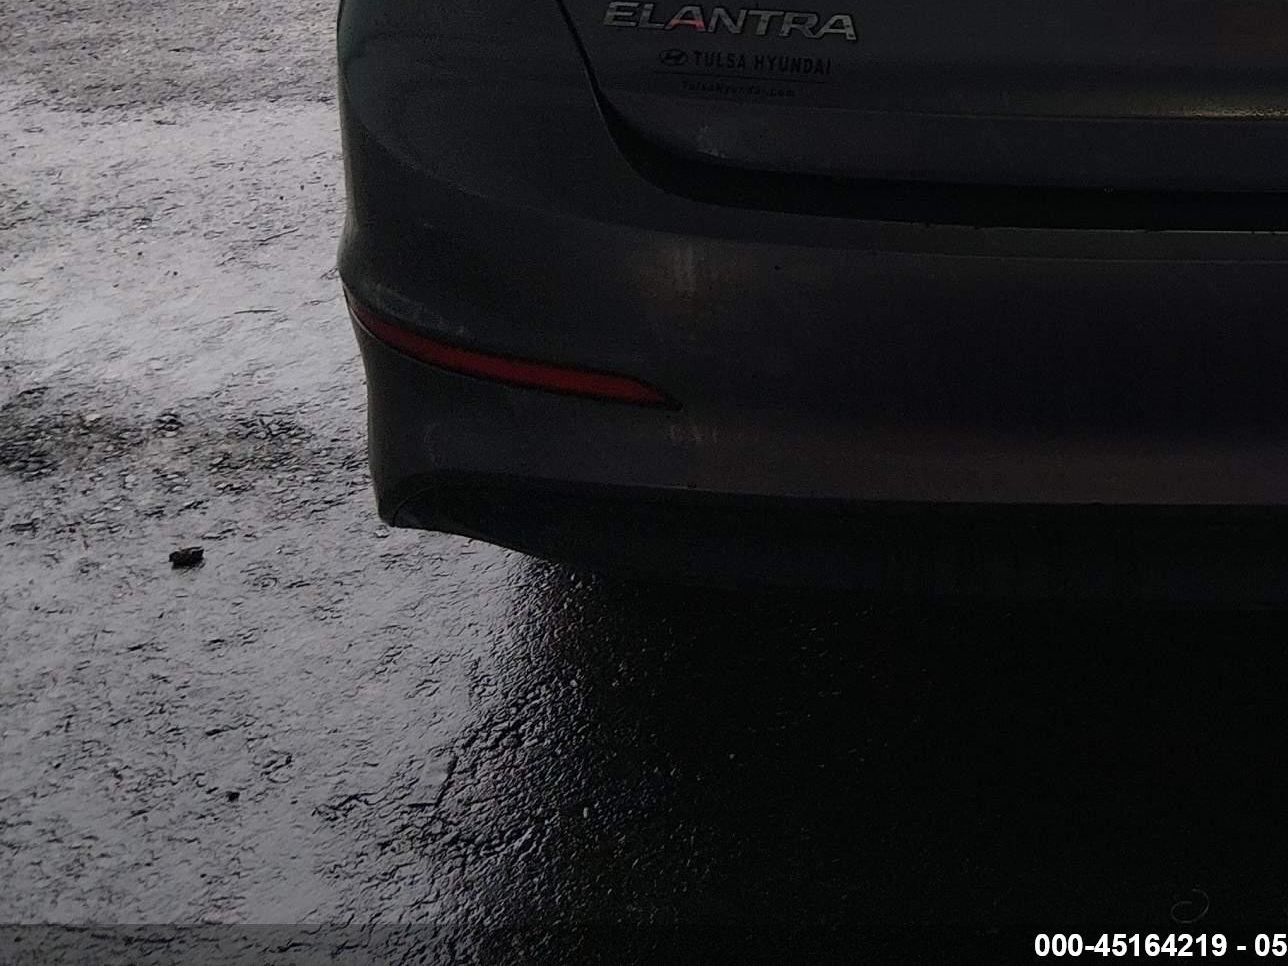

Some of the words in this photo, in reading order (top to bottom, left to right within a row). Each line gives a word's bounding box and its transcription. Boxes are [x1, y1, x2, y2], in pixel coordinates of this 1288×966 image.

[603, 0, 858, 42] ELANTRA
[694, 50, 746, 70] TULSA
[754, 55, 832, 76] HYUNDAI
